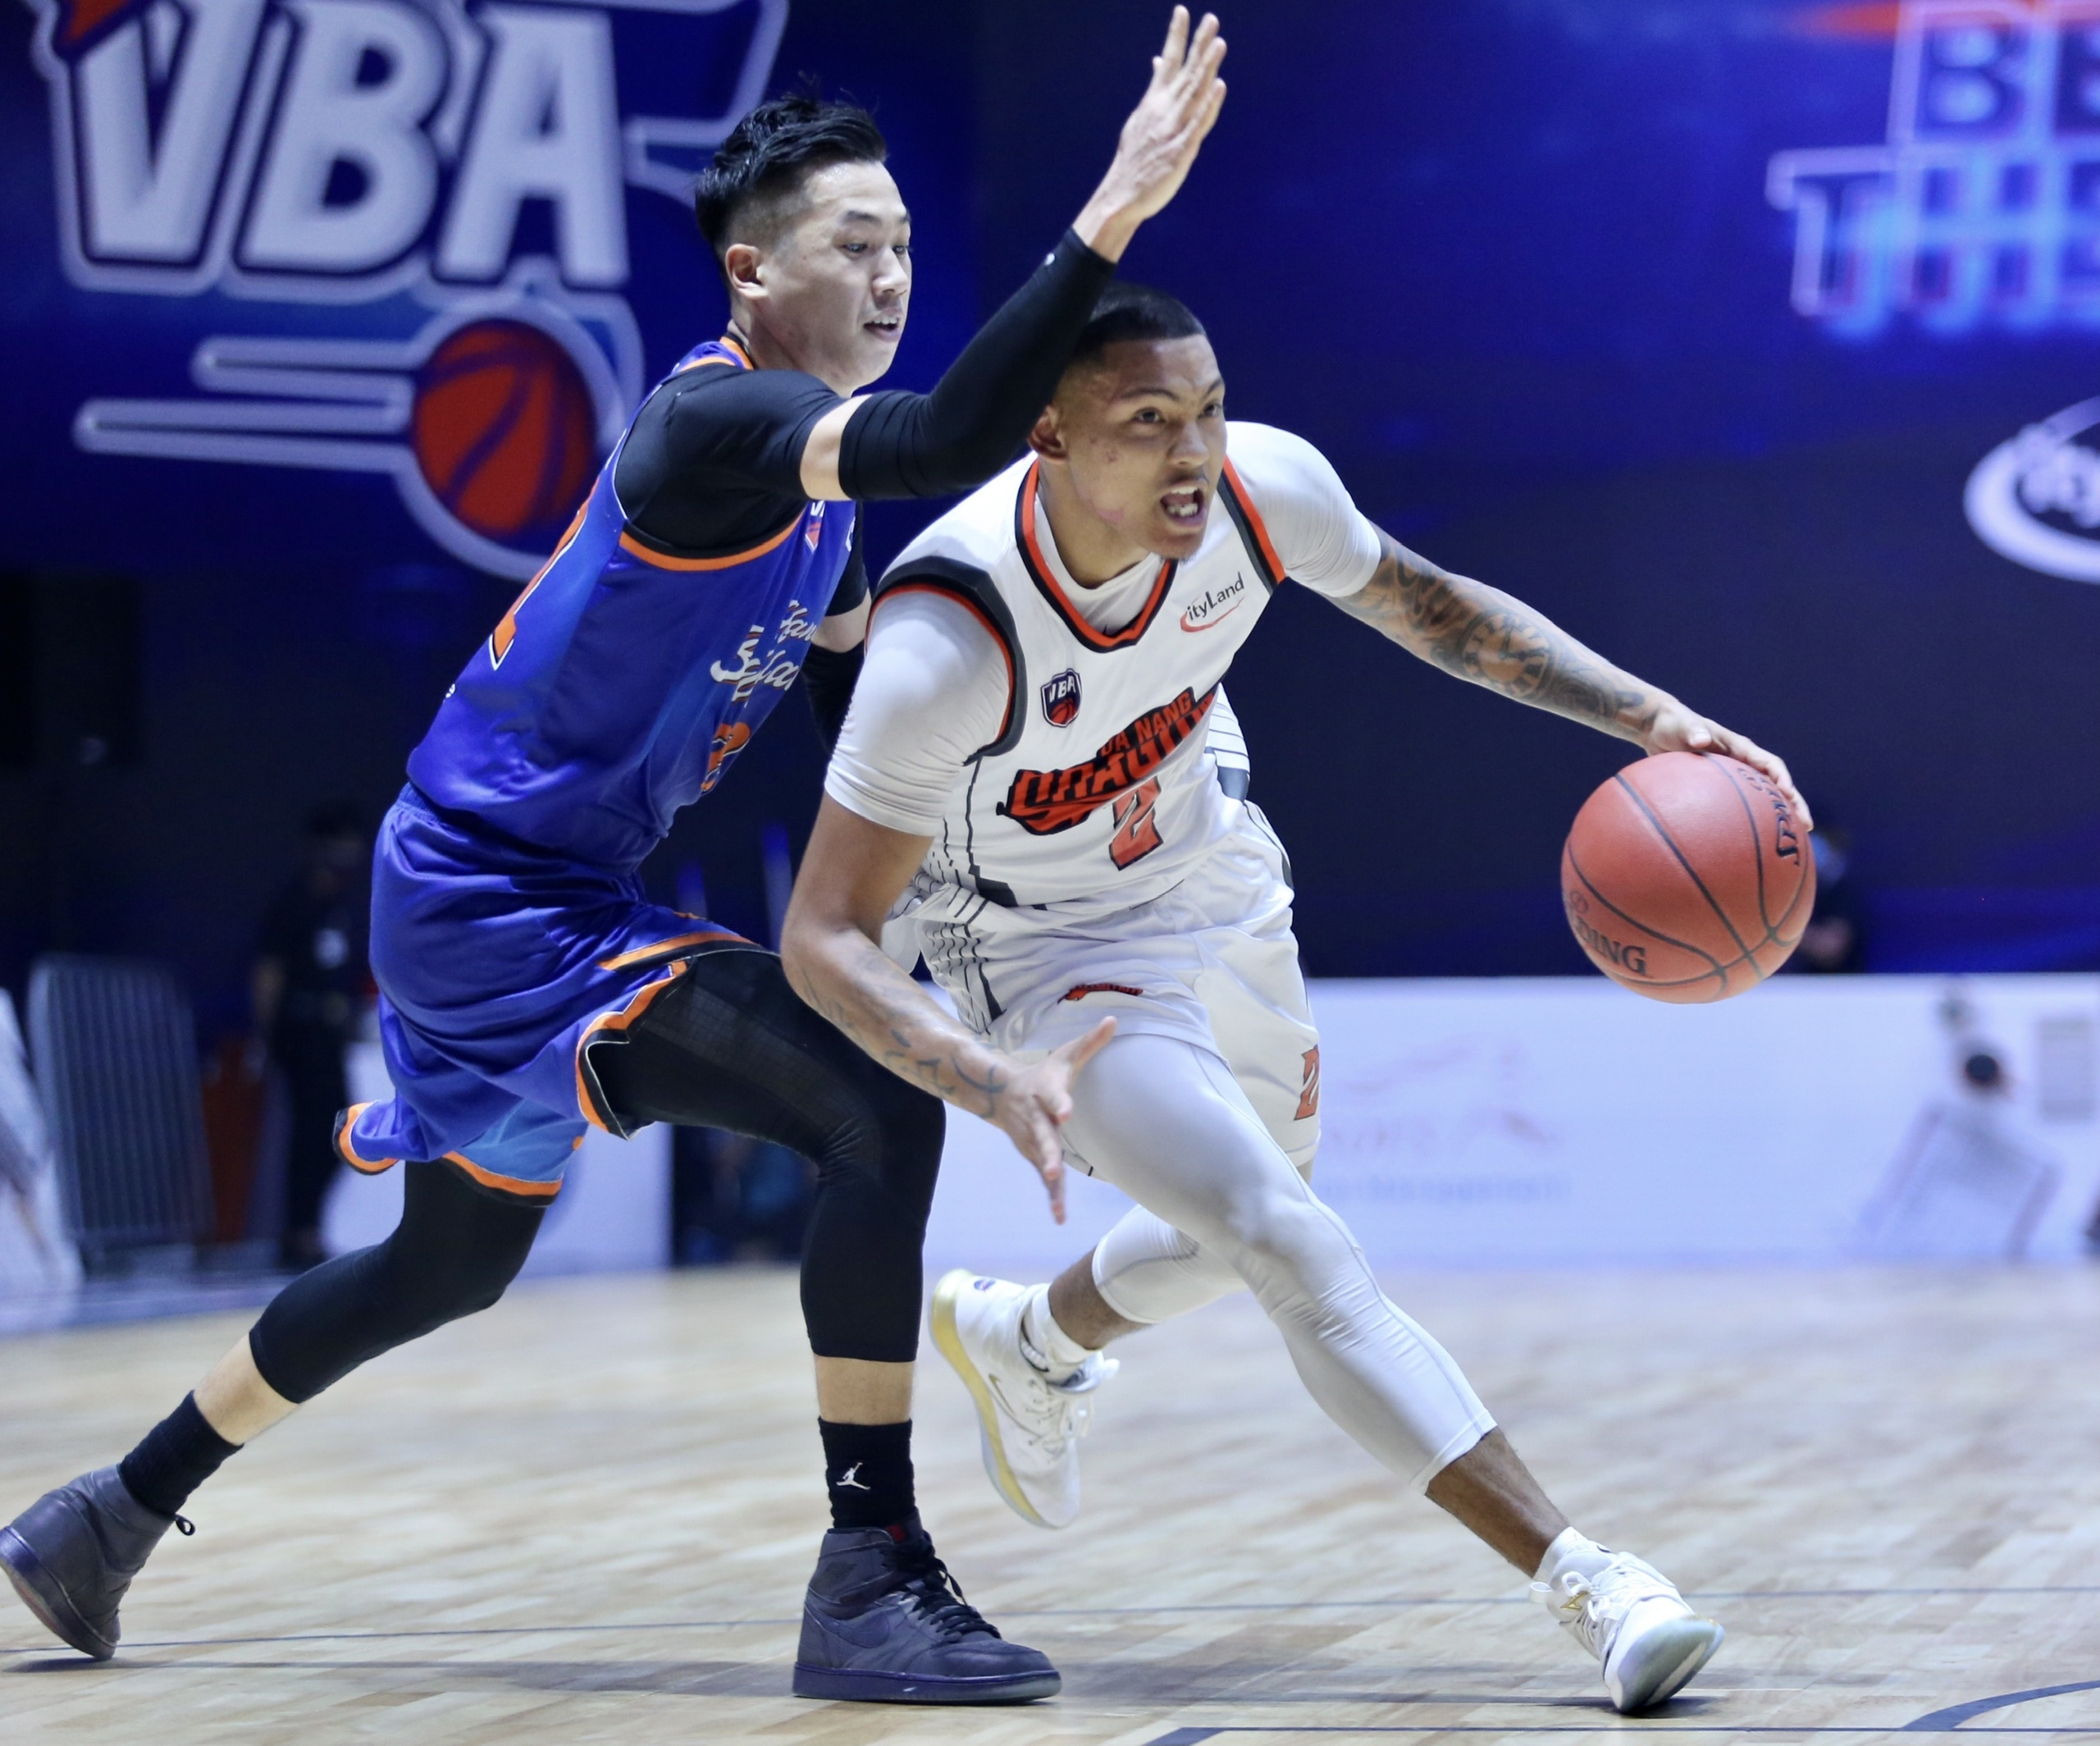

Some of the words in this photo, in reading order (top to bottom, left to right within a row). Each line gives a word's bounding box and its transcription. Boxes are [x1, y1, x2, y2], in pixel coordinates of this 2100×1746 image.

[72, 0, 630, 286] VBA
[1049, 675, 1076, 703] VBA
[1134, 691, 1192, 745] NANG
[1108, 775, 1164, 871] 2
